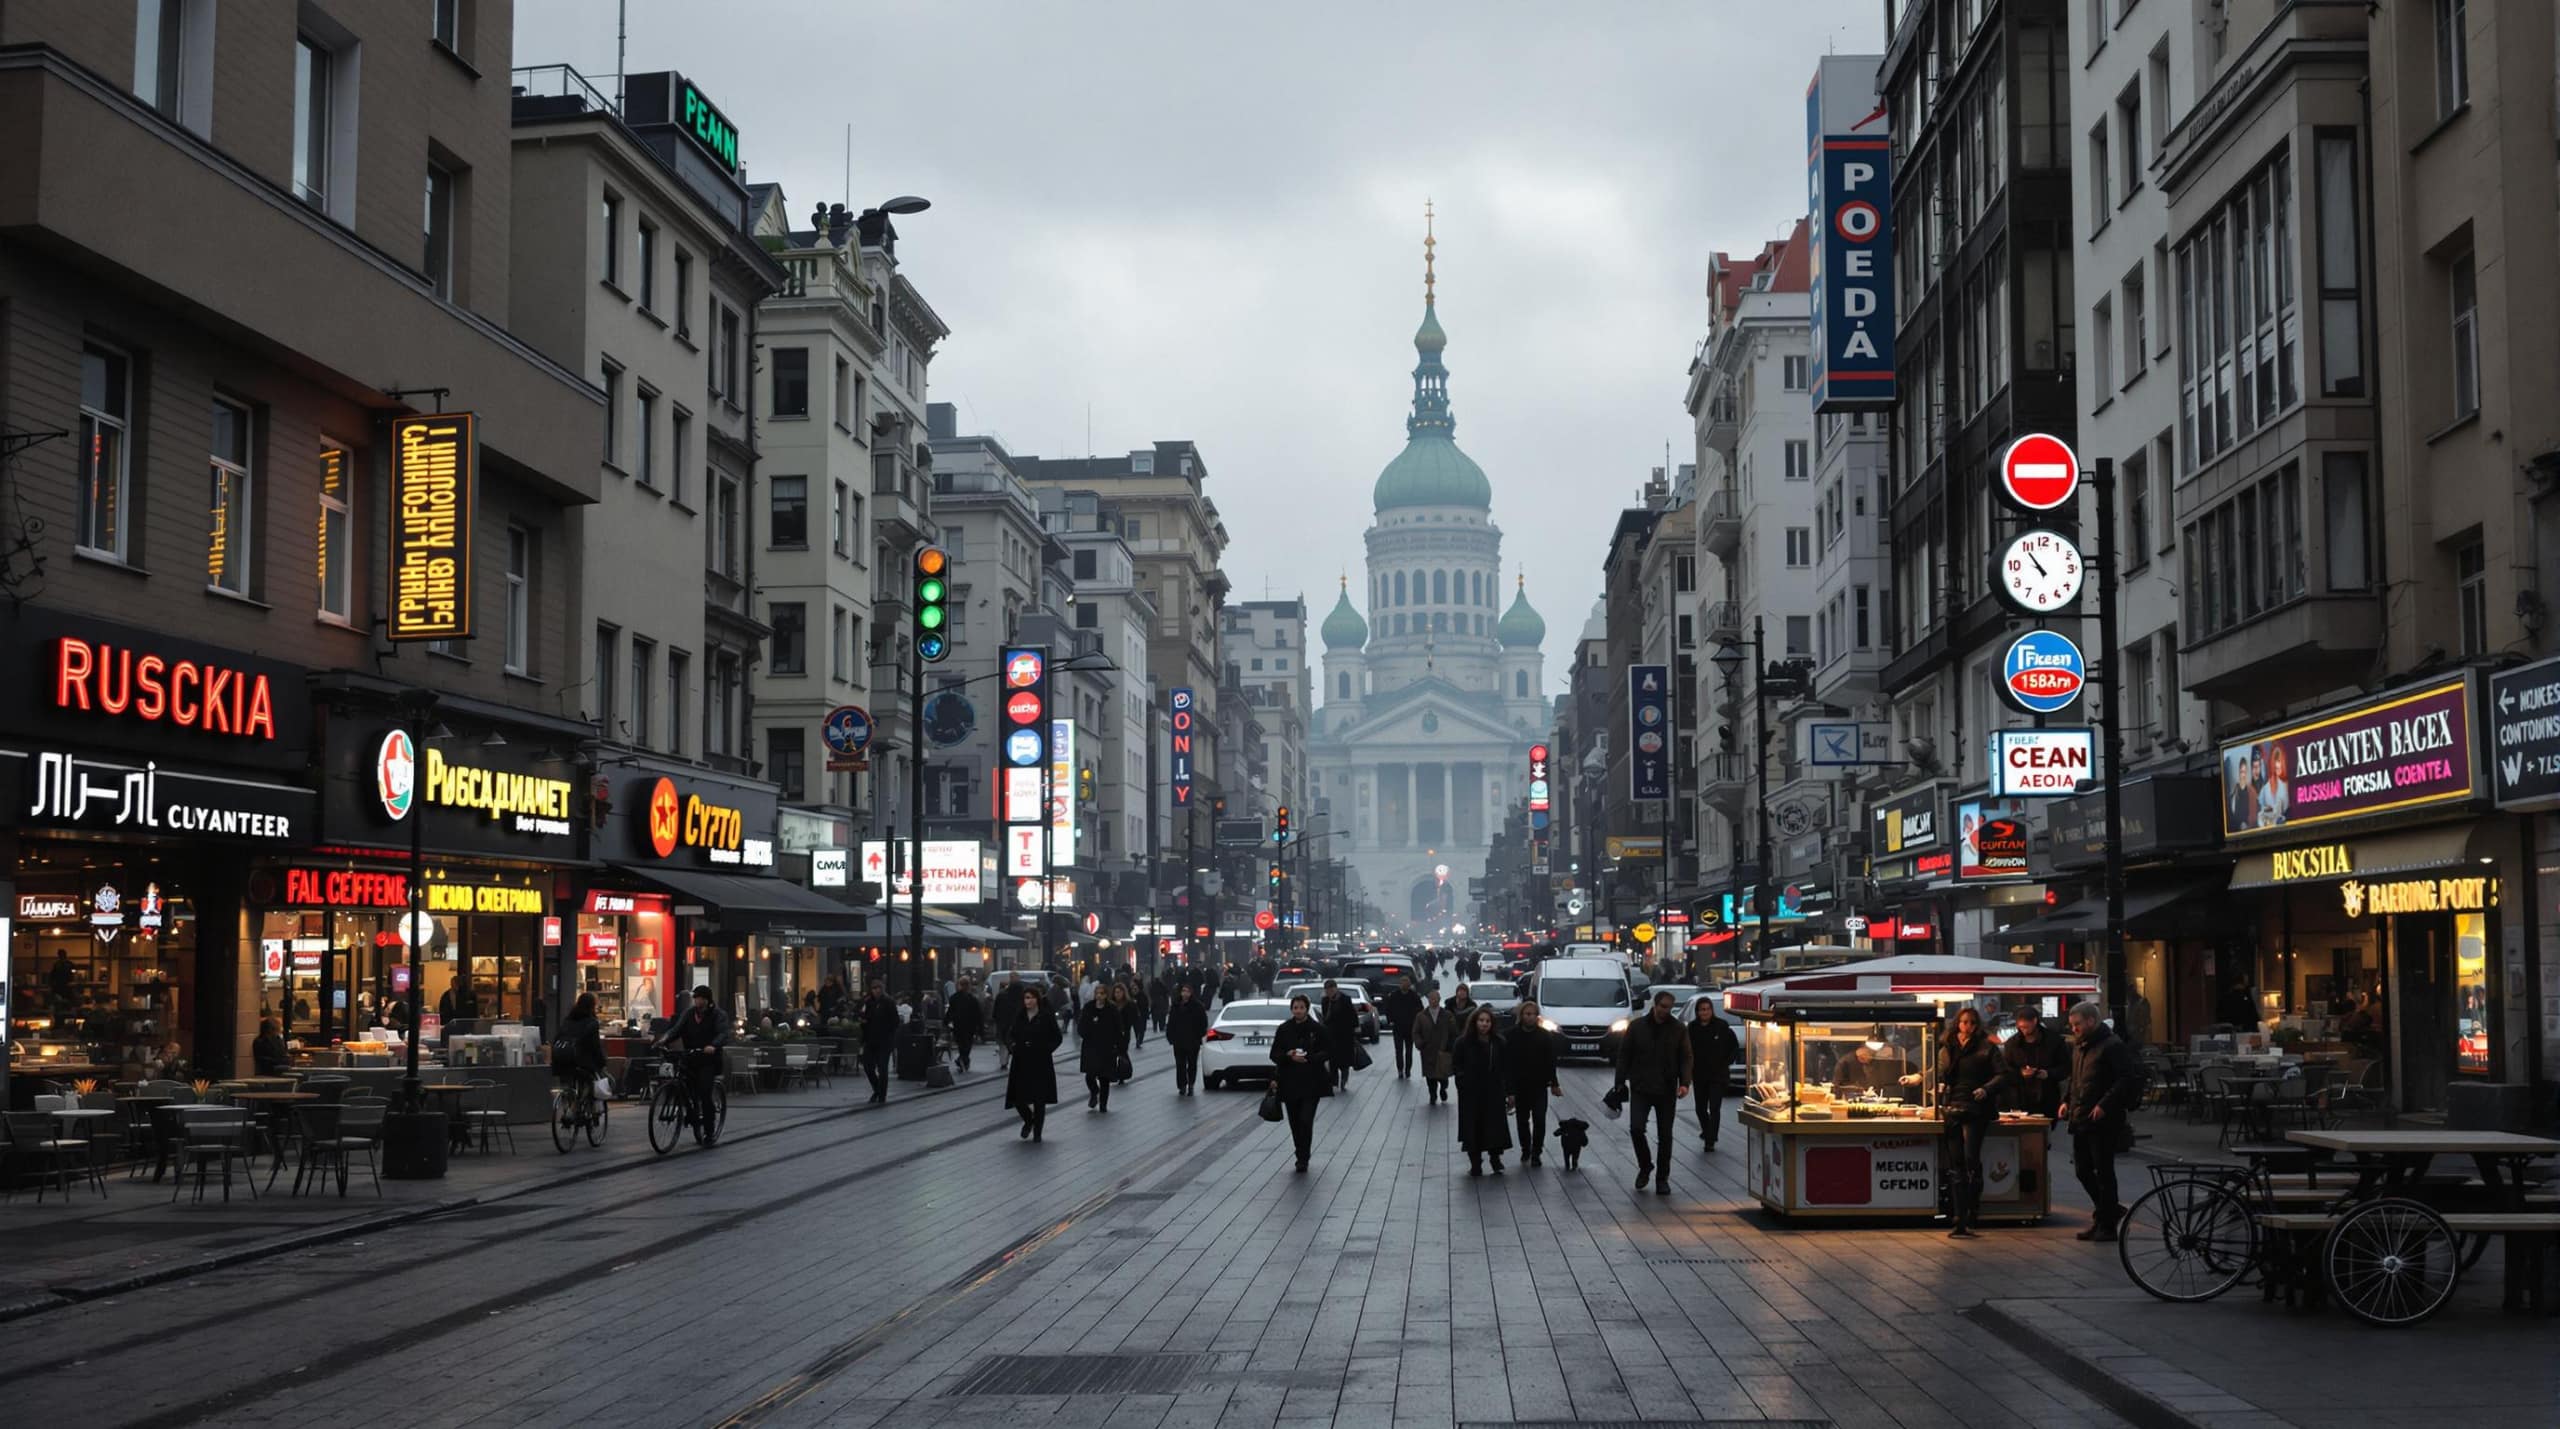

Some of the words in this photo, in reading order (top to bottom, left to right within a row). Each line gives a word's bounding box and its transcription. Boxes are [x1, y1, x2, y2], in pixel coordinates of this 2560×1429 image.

[2037, 537, 2049, 547] 12
[2008, 560, 2021, 571] 10
[2038, 593, 2047, 604] 6
[57, 636, 275, 740] RUSCKIA
[2009, 747, 2087, 768] CEAN
